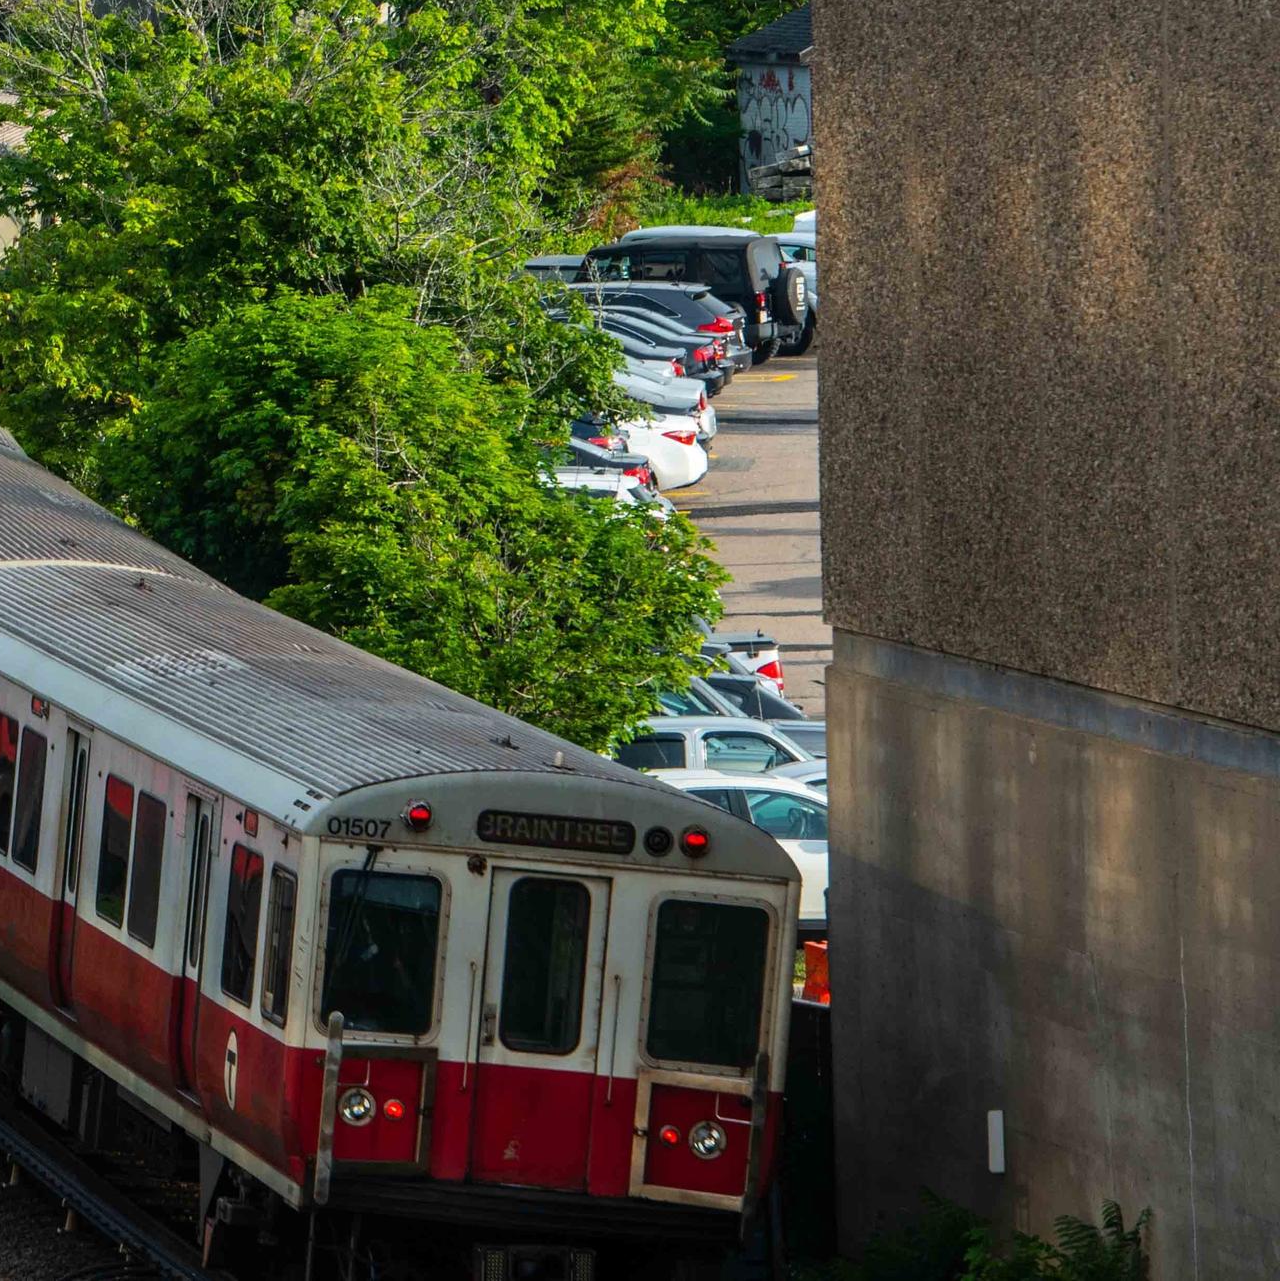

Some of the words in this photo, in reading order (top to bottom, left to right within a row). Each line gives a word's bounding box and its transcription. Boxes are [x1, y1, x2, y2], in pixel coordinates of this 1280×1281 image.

[328, 816, 392, 839] 01507
[481, 814, 629, 848] BRAINTREE
[226, 1048, 237, 1100] T
